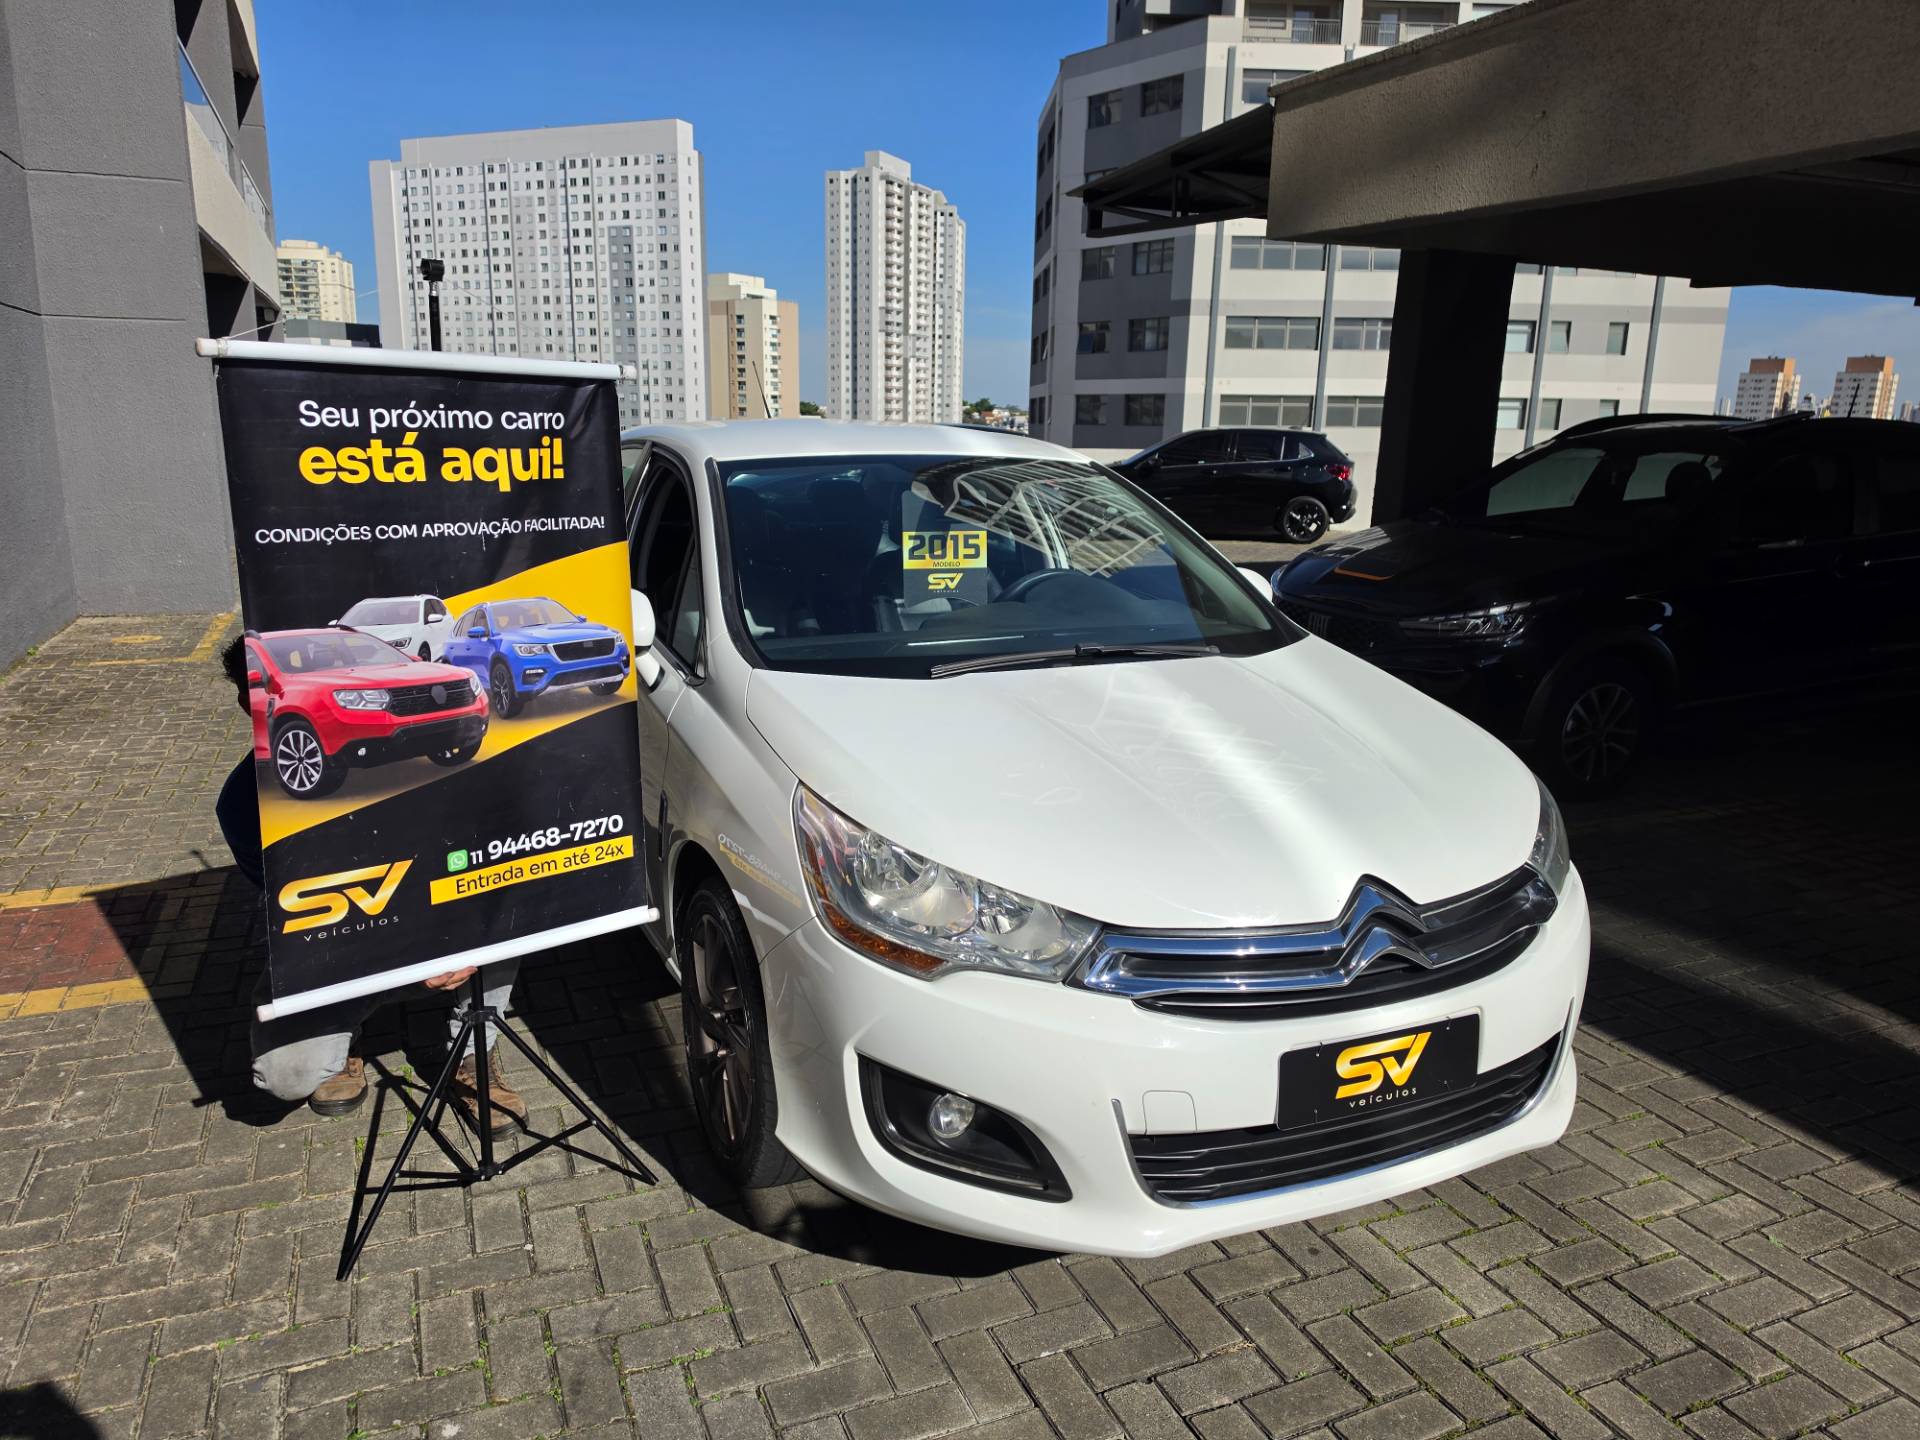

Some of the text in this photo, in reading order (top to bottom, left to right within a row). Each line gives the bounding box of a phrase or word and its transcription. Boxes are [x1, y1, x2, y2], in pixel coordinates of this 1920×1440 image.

[298, 399, 565, 434] Seu próximo carro
[298, 431, 565, 492] está aqui!
[255, 516, 605, 545] CONDIÇÕES COM APROVAÇÃO FACILITADA!
[907, 534, 981, 561] 2015
[927, 572, 964, 590] SV
[470, 814, 624, 865] 11 94468-7270
[456, 843, 625, 895] Entrada em até 24x
[278, 859, 414, 935] SV
[303, 915, 400, 942] veículos
[1335, 1031, 1433, 1100] SV
[1349, 1087, 1417, 1108] veículos
